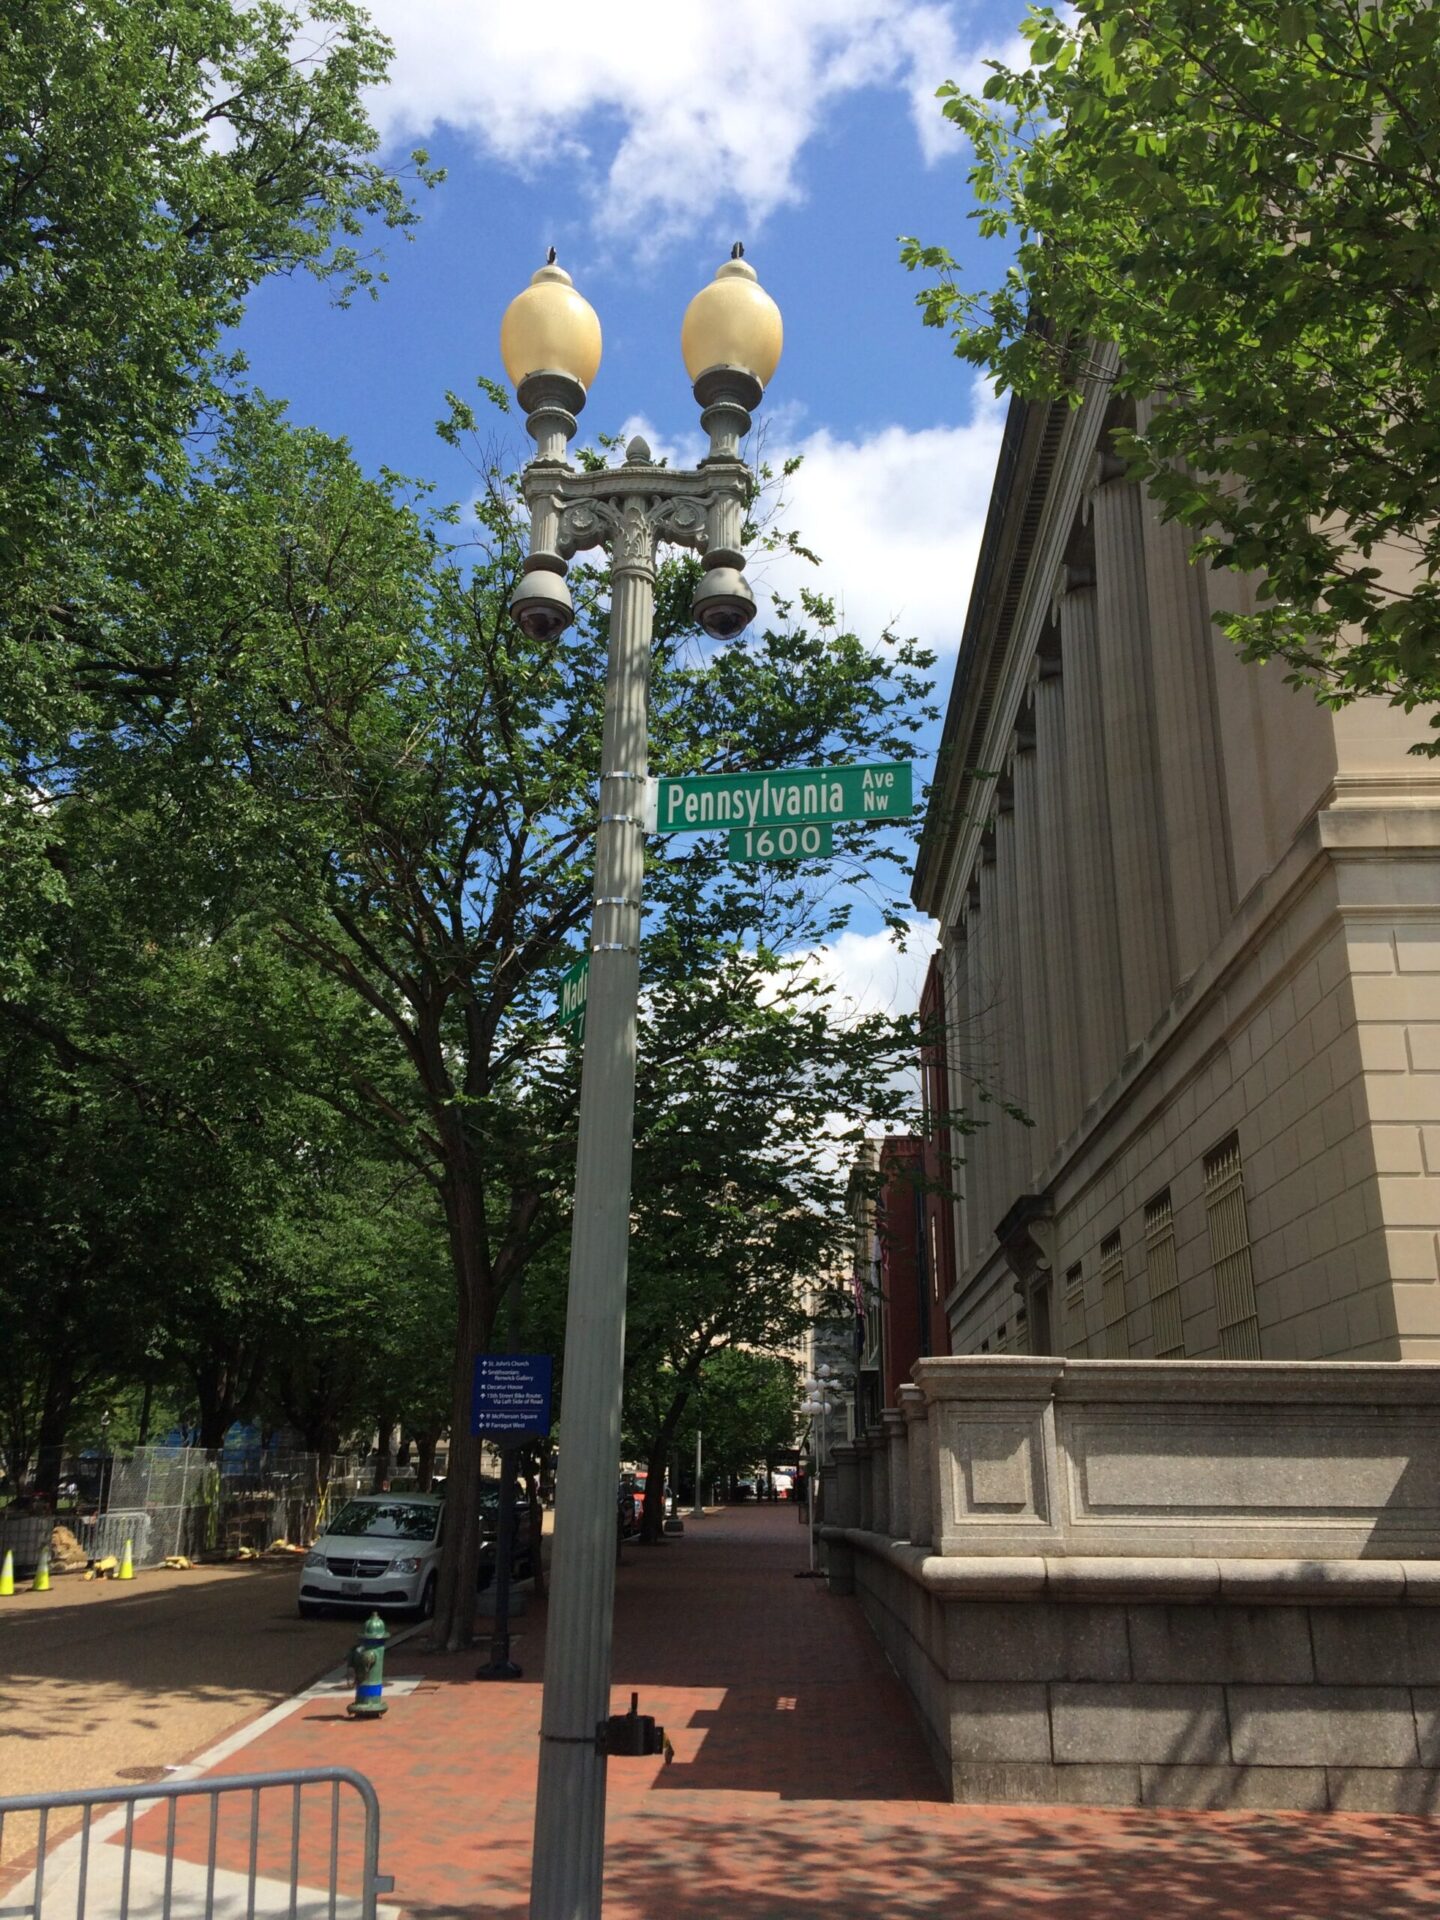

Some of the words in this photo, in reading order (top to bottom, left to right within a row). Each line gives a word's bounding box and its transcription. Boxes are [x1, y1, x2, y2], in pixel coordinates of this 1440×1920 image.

[667, 773, 843, 827] Pennsylvania
[862, 769, 894, 789] Ave
[744, 826, 821, 857] 1600
